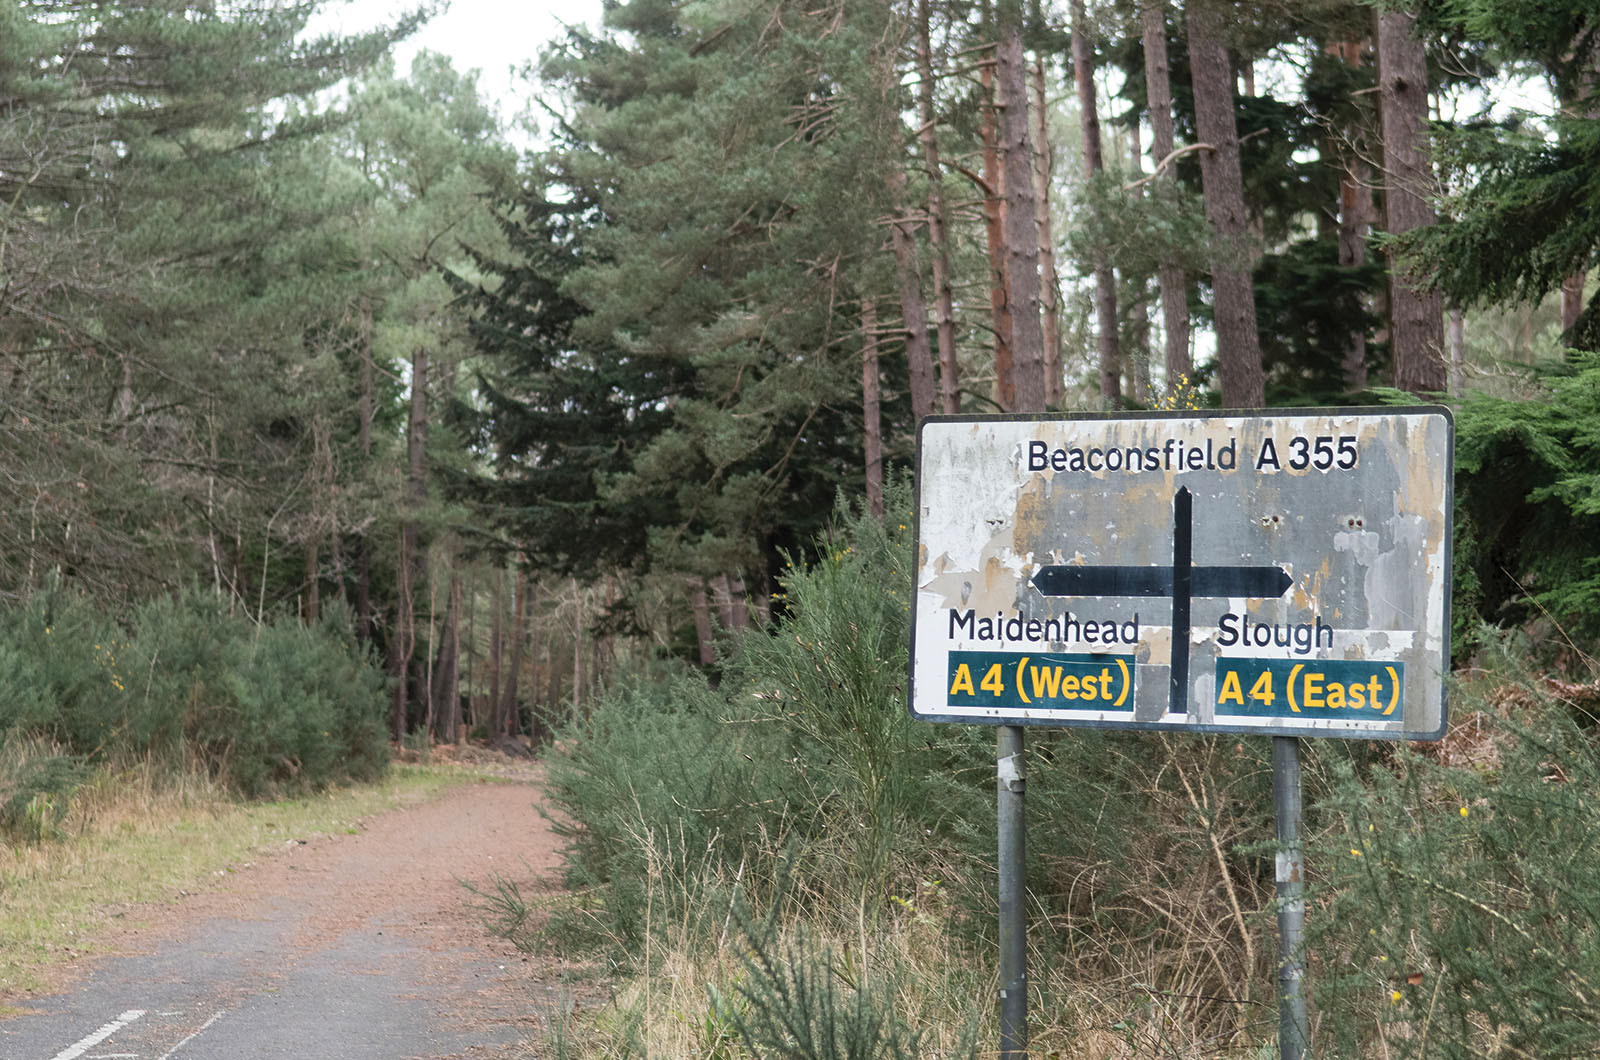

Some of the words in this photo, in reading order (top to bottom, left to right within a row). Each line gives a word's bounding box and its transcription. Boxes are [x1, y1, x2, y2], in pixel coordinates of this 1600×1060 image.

[1028, 438, 1236, 473] Beaconsfield
[948, 608, 1138, 644] Maidenhead
[1218, 613, 1334, 655] Slough
[1015, 656, 1130, 707] (West)
[1287, 663, 1401, 716] (East)
